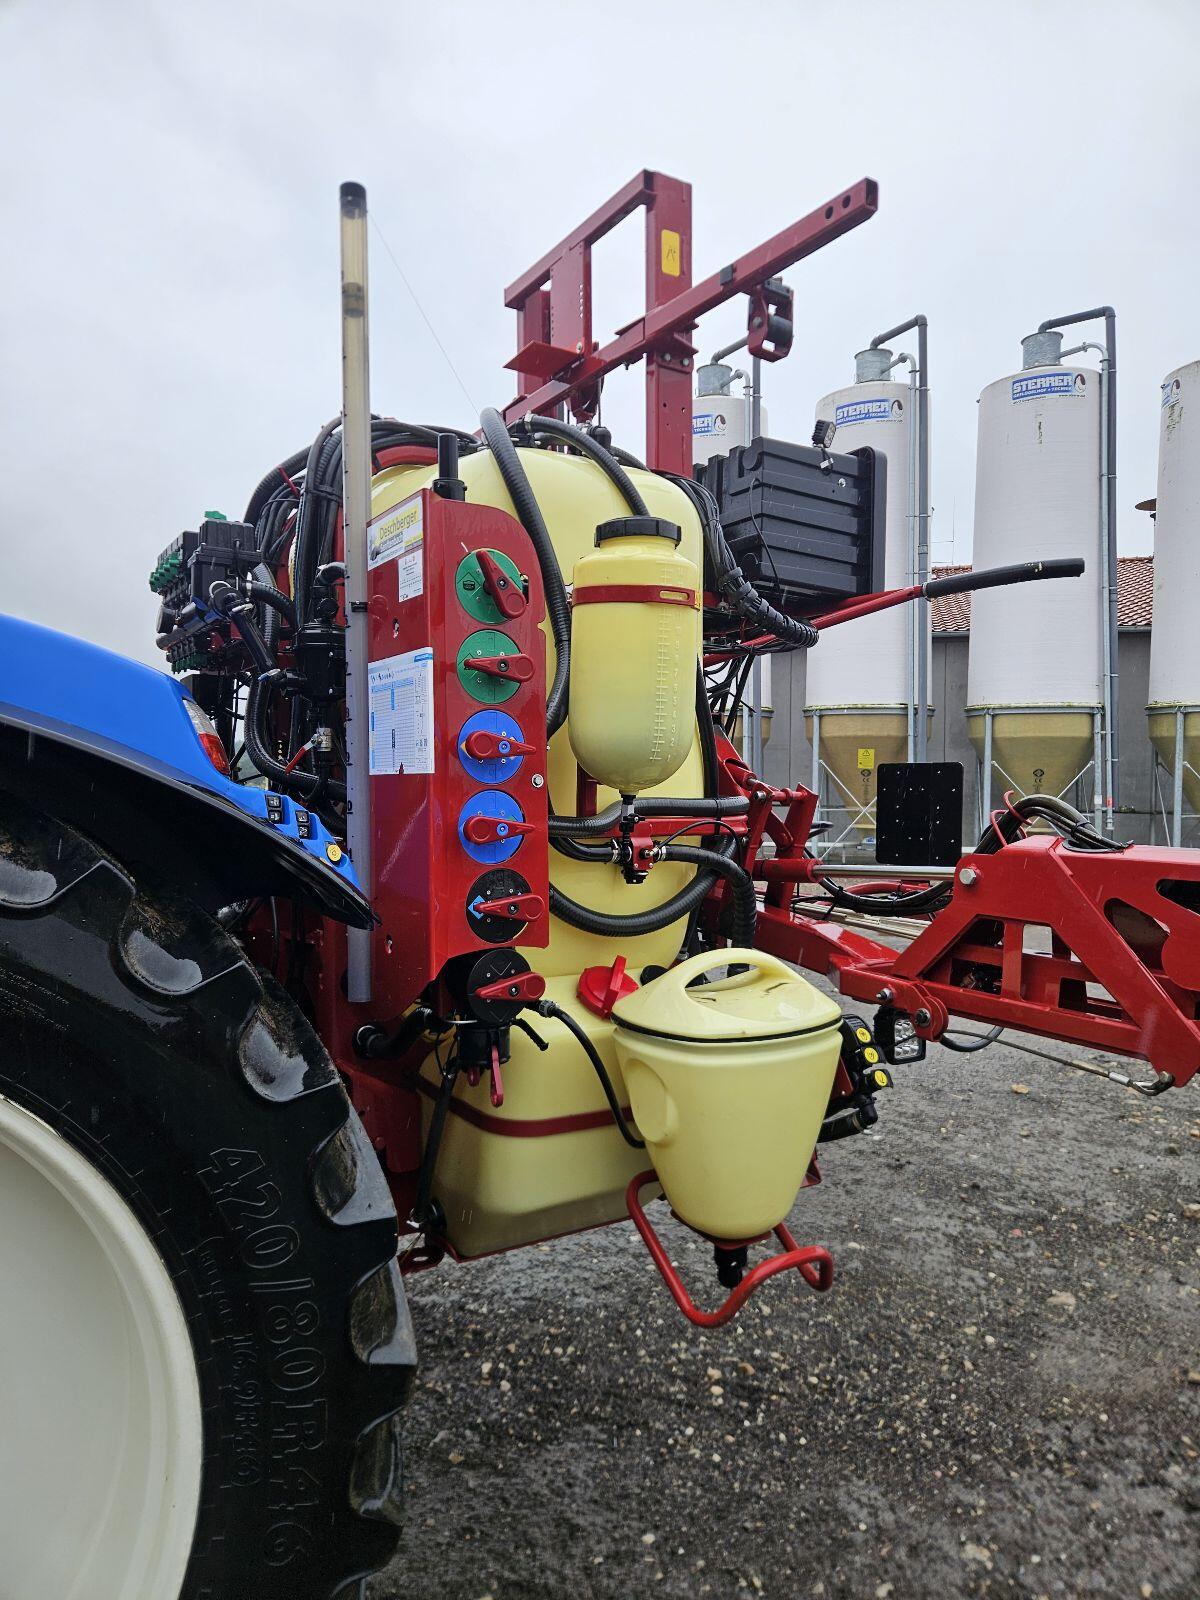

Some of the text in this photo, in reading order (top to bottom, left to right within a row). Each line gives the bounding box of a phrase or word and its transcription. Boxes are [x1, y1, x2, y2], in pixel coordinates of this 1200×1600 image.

[1012, 376, 1073, 395] STERRER
[836, 401, 889, 419] STERRER
[379, 509, 418, 540] Deschberger
